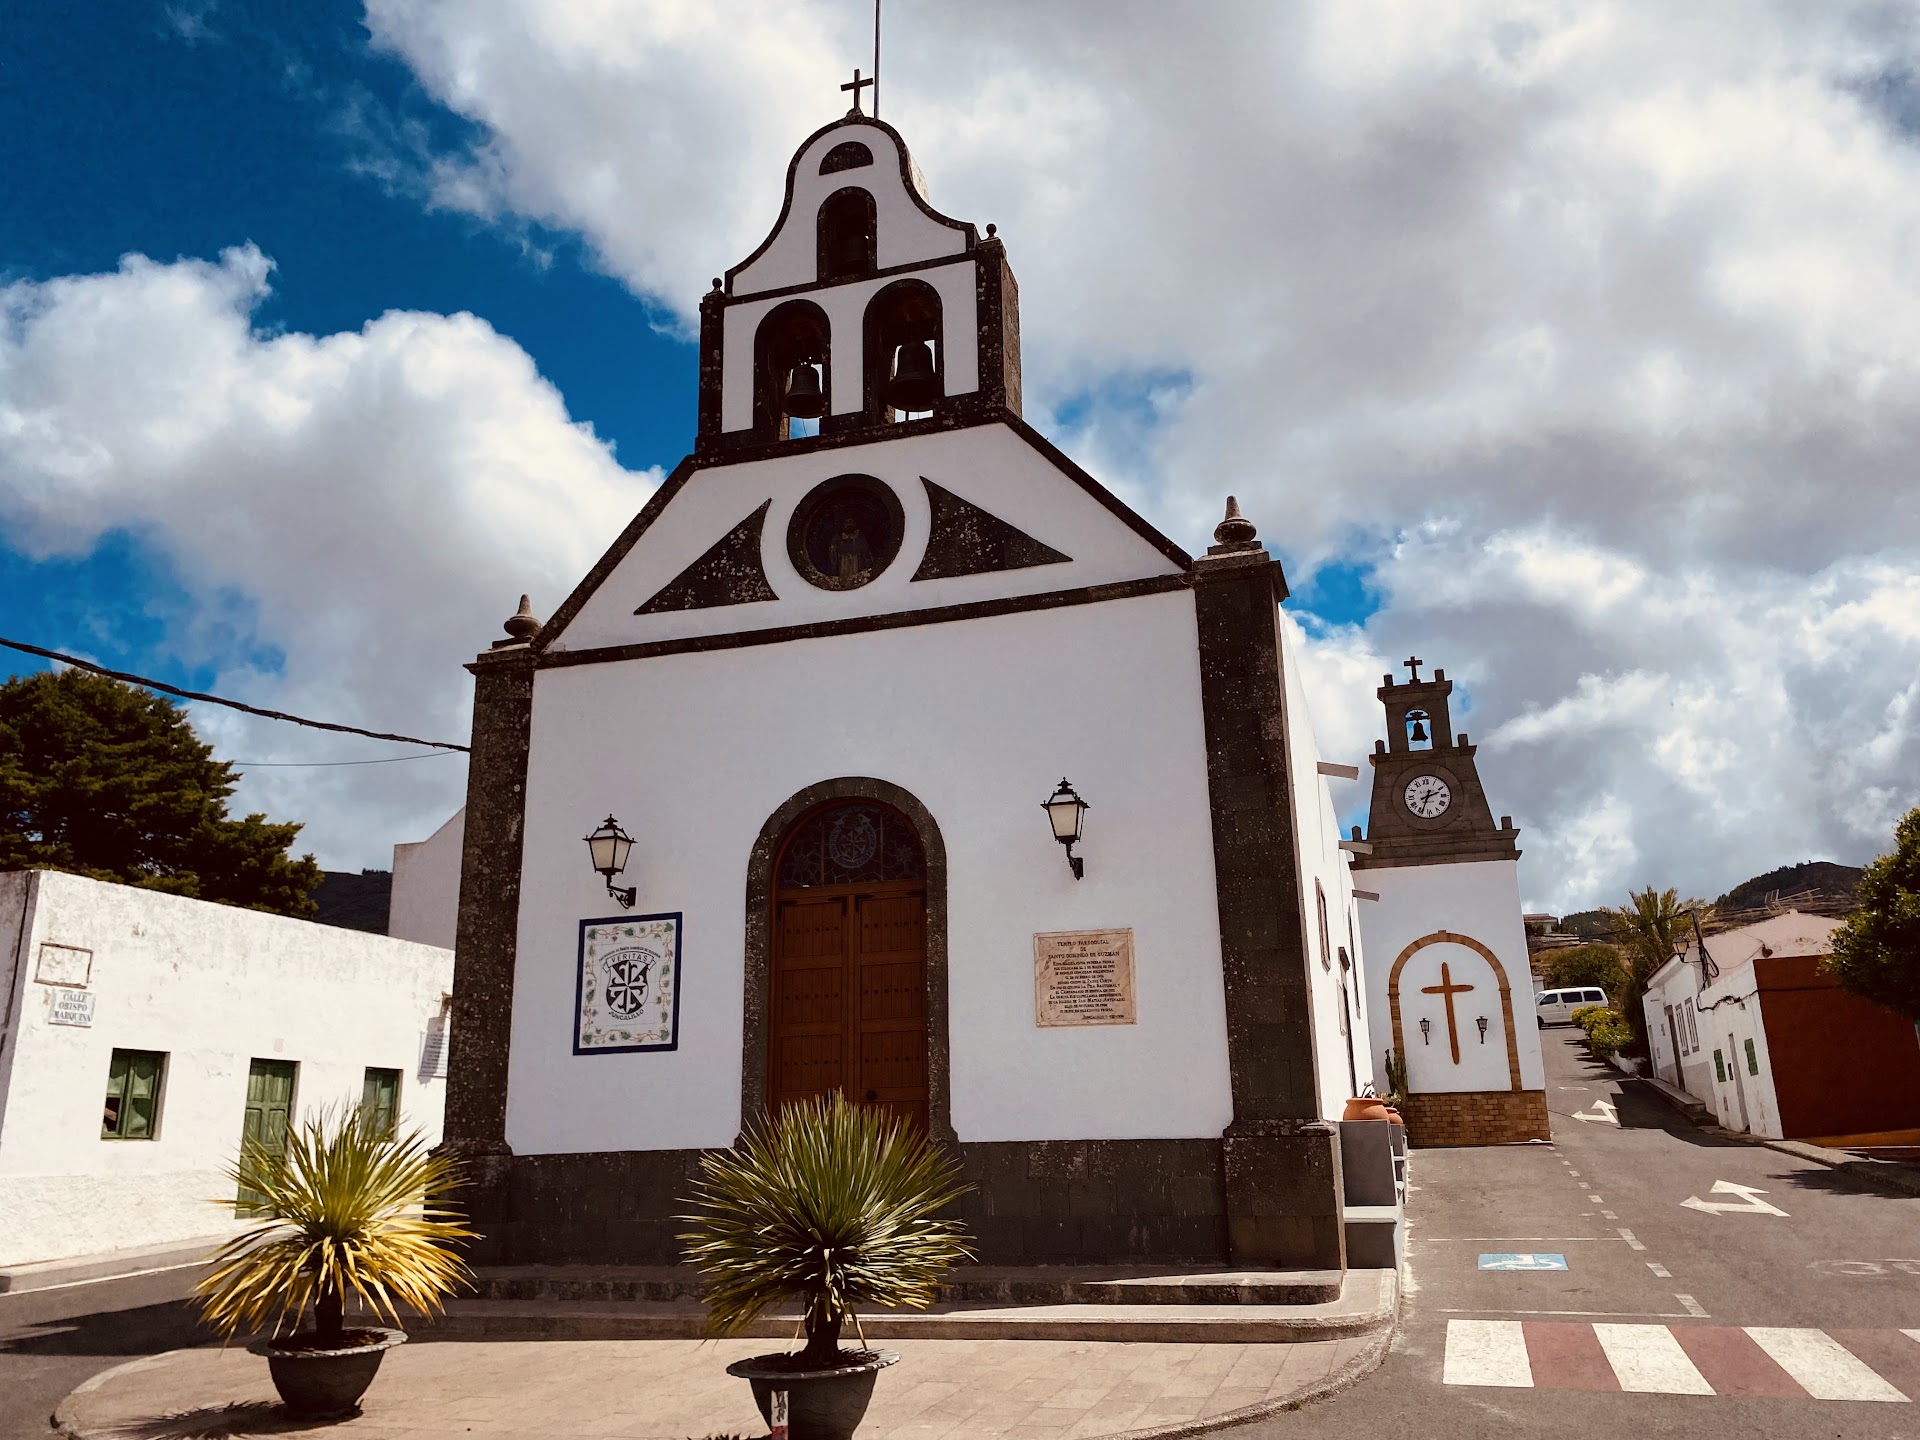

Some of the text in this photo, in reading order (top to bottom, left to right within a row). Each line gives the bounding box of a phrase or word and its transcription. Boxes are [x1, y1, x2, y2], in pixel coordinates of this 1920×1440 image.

[612, 953, 647, 962] VERITAS
[63, 994, 87, 1002] CALLE
[59, 1002, 87, 1011] OBISPO
[54, 1011, 91, 1021] MARQUINA
[609, 1009, 644, 1020] JUNCALILLO
